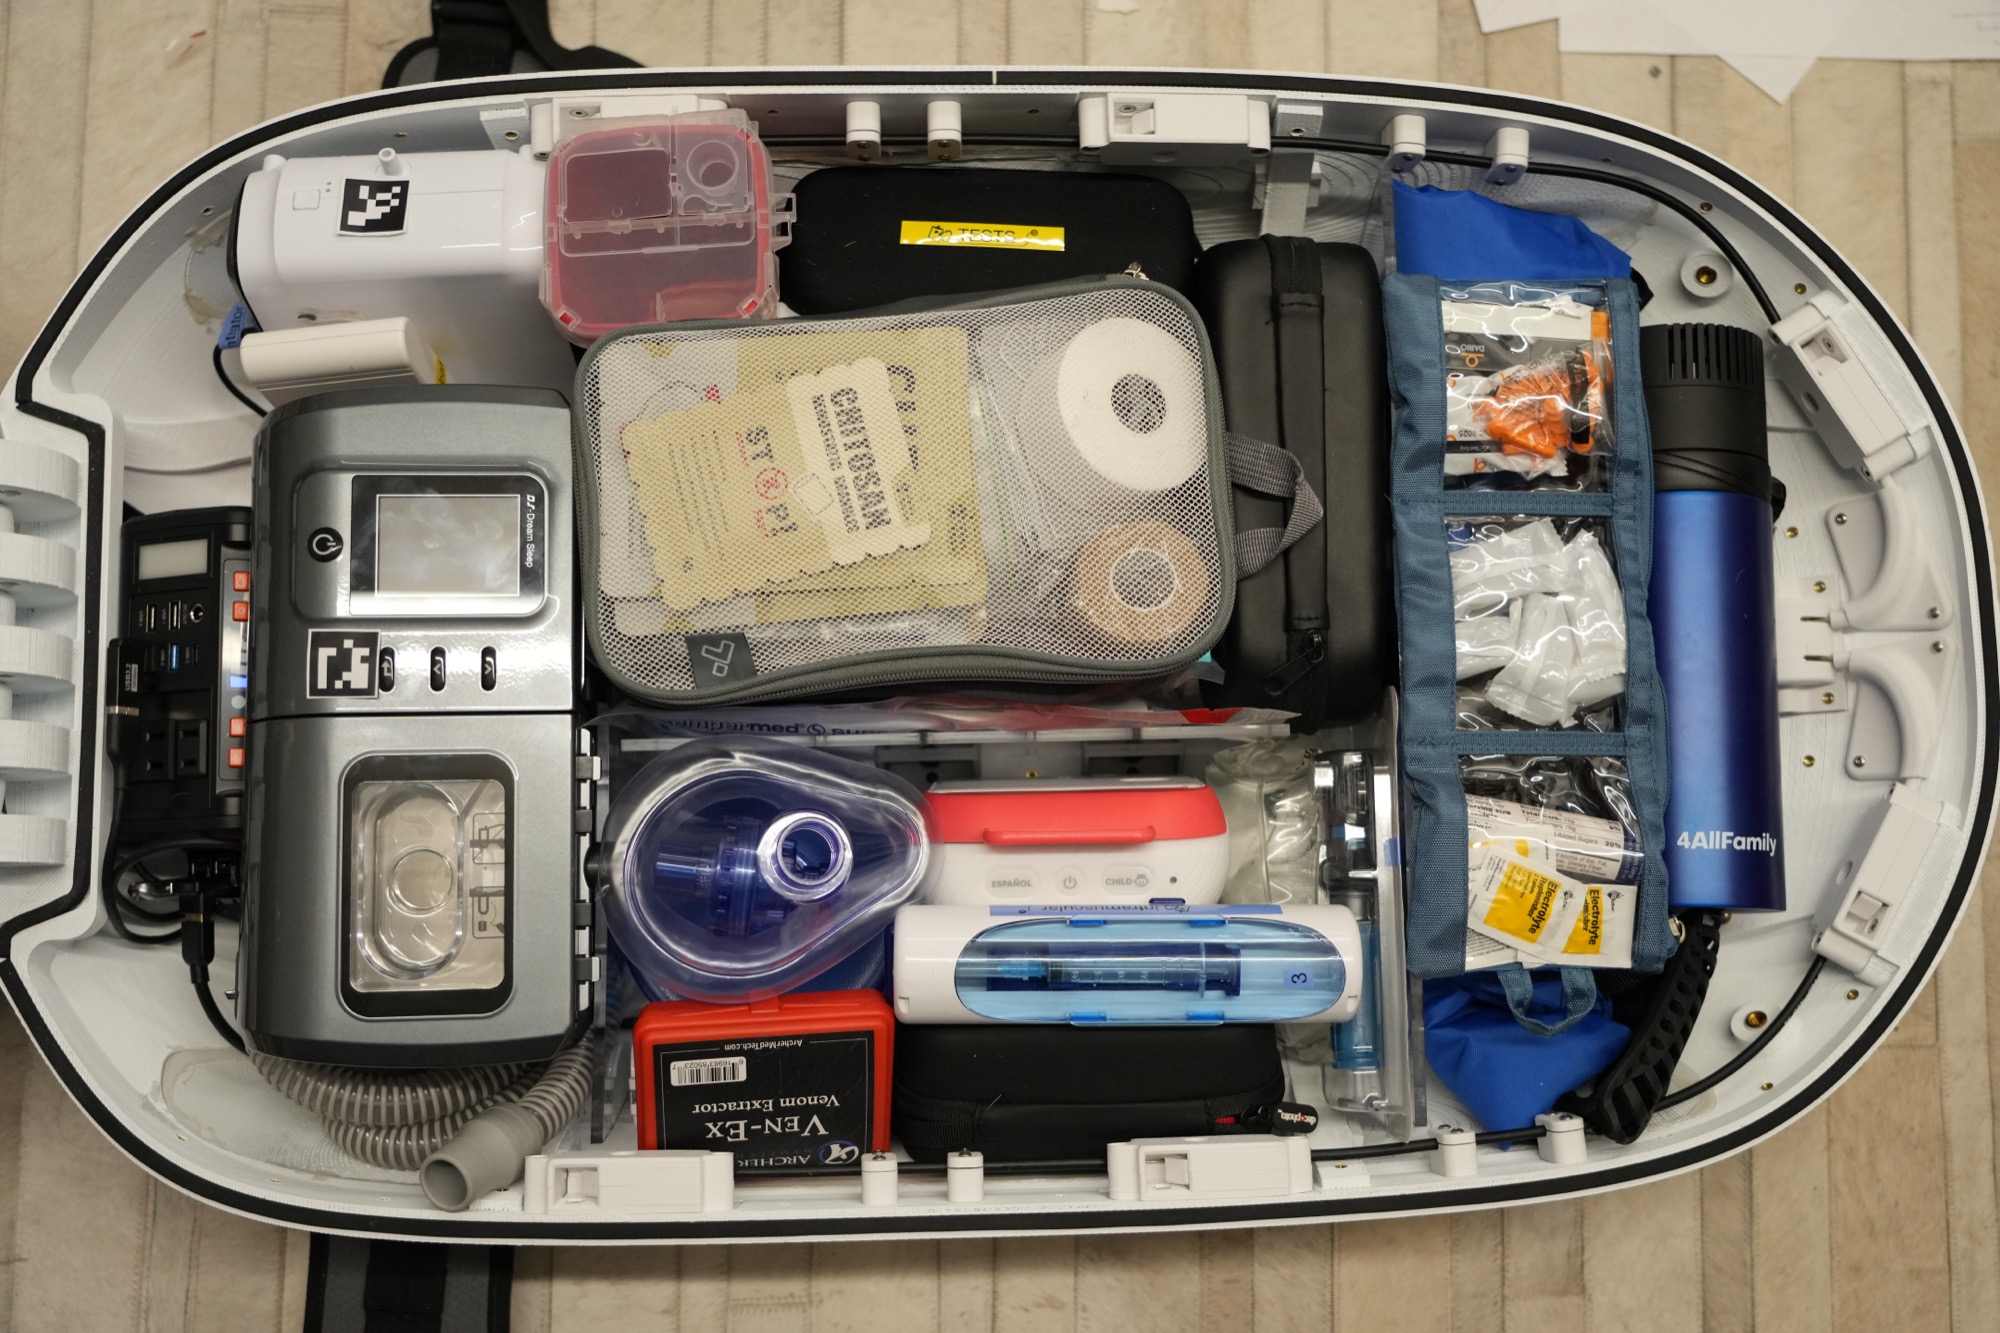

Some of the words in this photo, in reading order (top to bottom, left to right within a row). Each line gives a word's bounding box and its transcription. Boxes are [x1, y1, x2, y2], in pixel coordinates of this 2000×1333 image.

[1460, 344, 1485, 352] DARIO
[525, 543, 535, 568] Sleep
[1676, 830, 1777, 857] 4AllFamily
[991, 878, 1033, 888] ESPAÑOL
[1105, 877, 1133, 886] CHILD
[1527, 876, 1548, 918] Replenisher
[1528, 880, 1559, 935] Electrolyte
[1588, 889, 1601, 945] Electrolyte
[724, 1038, 803, 1051] ArcherMedTech.com
[691, 1098, 774, 1114] Extractor
[779, 1095, 841, 1107] Venom
[737, 1154, 811, 1168] ARCHER
